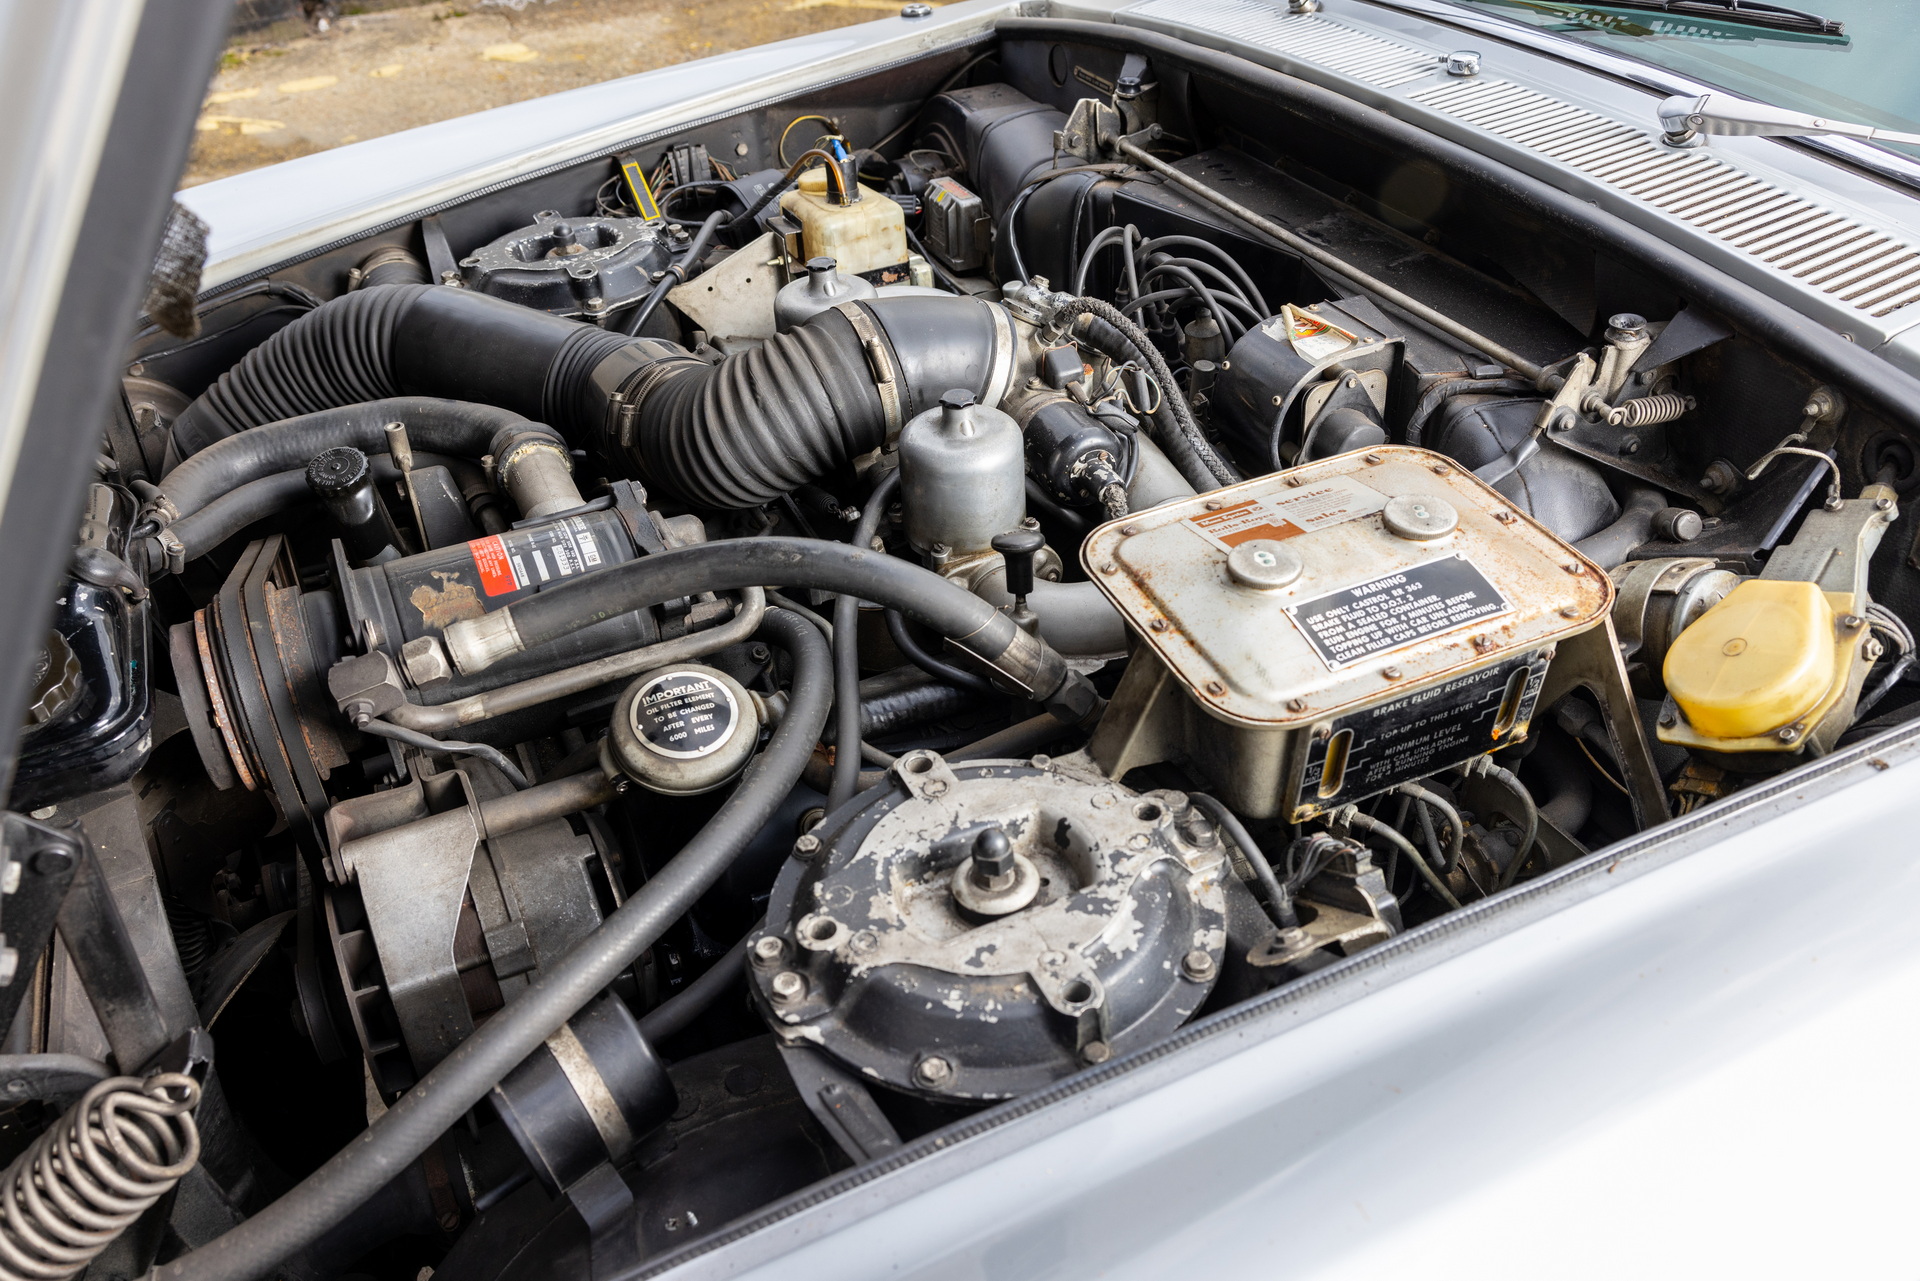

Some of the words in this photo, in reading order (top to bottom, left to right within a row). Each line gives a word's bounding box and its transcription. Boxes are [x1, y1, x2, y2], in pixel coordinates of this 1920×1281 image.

[1276, 488, 1333, 505] service
[1305, 509, 1347, 522] sales
[492, 540, 504, 560] CAUTION
[1351, 575, 1406, 597] WARNING
[1306, 614, 1325, 624] USE
[1326, 605, 1350, 618] ONLY
[1352, 593, 1390, 609] CASTROL
[1391, 588, 1405, 596] RR
[1405, 582, 1422, 592] 363
[1311, 617, 1341, 631] BRAKE
[1341, 610, 1365, 622] FLUID
[1366, 606, 1379, 614] TO
[1380, 598, 1406, 609] D.O.T.
[1318, 626, 1346, 639] FROM
[1356, 612, 1388, 626] SEALED
[1390, 595, 1441, 615] CONTAINER.
[1323, 635, 1345, 646] RUN
[1345, 624, 1379, 639] ENGINE
[1379, 618, 1399, 628] FOR
[1408, 602, 1445, 619] MINUTES
[1445, 591, 1476, 606] BEFORE
[1329, 636, 1369, 653] TOPPING
[1370, 631, 1383, 639] UP
[1384, 623, 1409, 634] WITH
[1410, 617, 1429, 626] CAR
[1429, 602, 1472, 620] UNLADEN.
[1336, 648, 1366, 661] CLEAN
[1366, 638, 1393, 651] FILLER
[1394, 630, 1416, 641] CAPS
[1417, 618, 1450, 634] BEFORE
[1450, 603, 1499, 622] REMOVING.
[642, 681, 709, 704] IMPORTANT
[660, 699, 683, 710] FILTER
[684, 693, 714, 703] ELEMENT
[1373, 699, 1408, 717] BRAKE
[1412, 688, 1441, 704] FLUID
[1445, 667, 1500, 693] RESERVOIR
[663, 721, 685, 732] AFTER
[691, 713, 713, 724] EVERY
[680, 703, 715, 715] CHANGED
[1381, 729, 1397, 740] TOP
[1401, 724, 1412, 733] UP
[1430, 712, 1448, 723] THIS
[1451, 702, 1473, 716] LEVEL
[669, 732, 687, 741] 6000
[694, 724, 715, 734] MILES
[1384, 735, 1430, 756] MINIMUM
[1433, 724, 1462, 739] LEVEL
[1367, 764, 1391, 777] AFTER
[1395, 750, 1435, 766] RUNNING
[1439, 736, 1469, 751] ENGINE
[1370, 759, 1390, 769] WITH
[1394, 752, 1410, 761] CAR
[1414, 736, 1454, 754] UNLADEN
[1366, 773, 1383, 783] FOR
[1394, 756, 1429, 772] MINUTES
